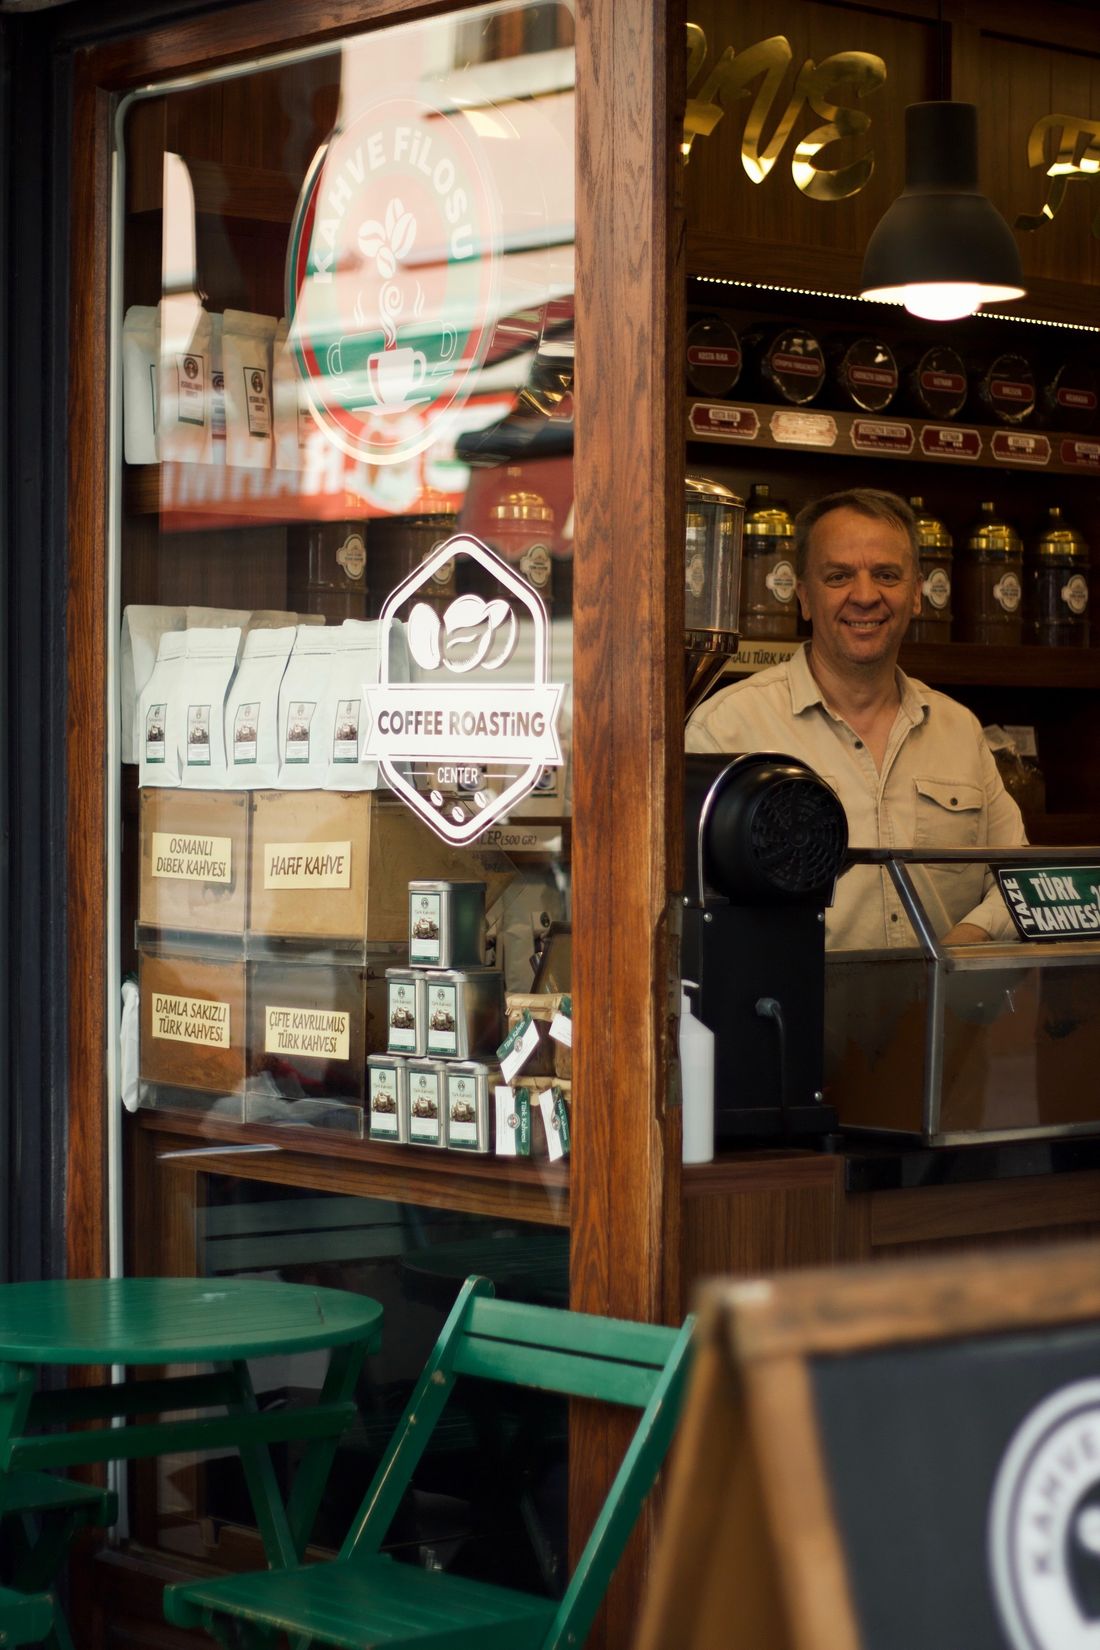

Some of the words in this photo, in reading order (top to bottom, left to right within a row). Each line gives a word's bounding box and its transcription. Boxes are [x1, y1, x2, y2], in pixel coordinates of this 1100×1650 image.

[313, 131, 387, 283] KAHVE
[377, 710, 443, 735] COFFEE
[437, 767, 479, 784] CENTER
[169, 837, 214, 857] OSMANLI
[478, 830, 502, 845] LEP
[304, 854, 345, 876] KAHVE
[1029, 872, 1082, 902] TÜRK
[1003, 877, 1035, 929] TAZE
[155, 998, 188, 1018] DAMLA
[191, 1003, 227, 1024] SAKIZLI
[158, 1017, 183, 1036] TÜRK
[278, 1030, 299, 1050] TÜRK
